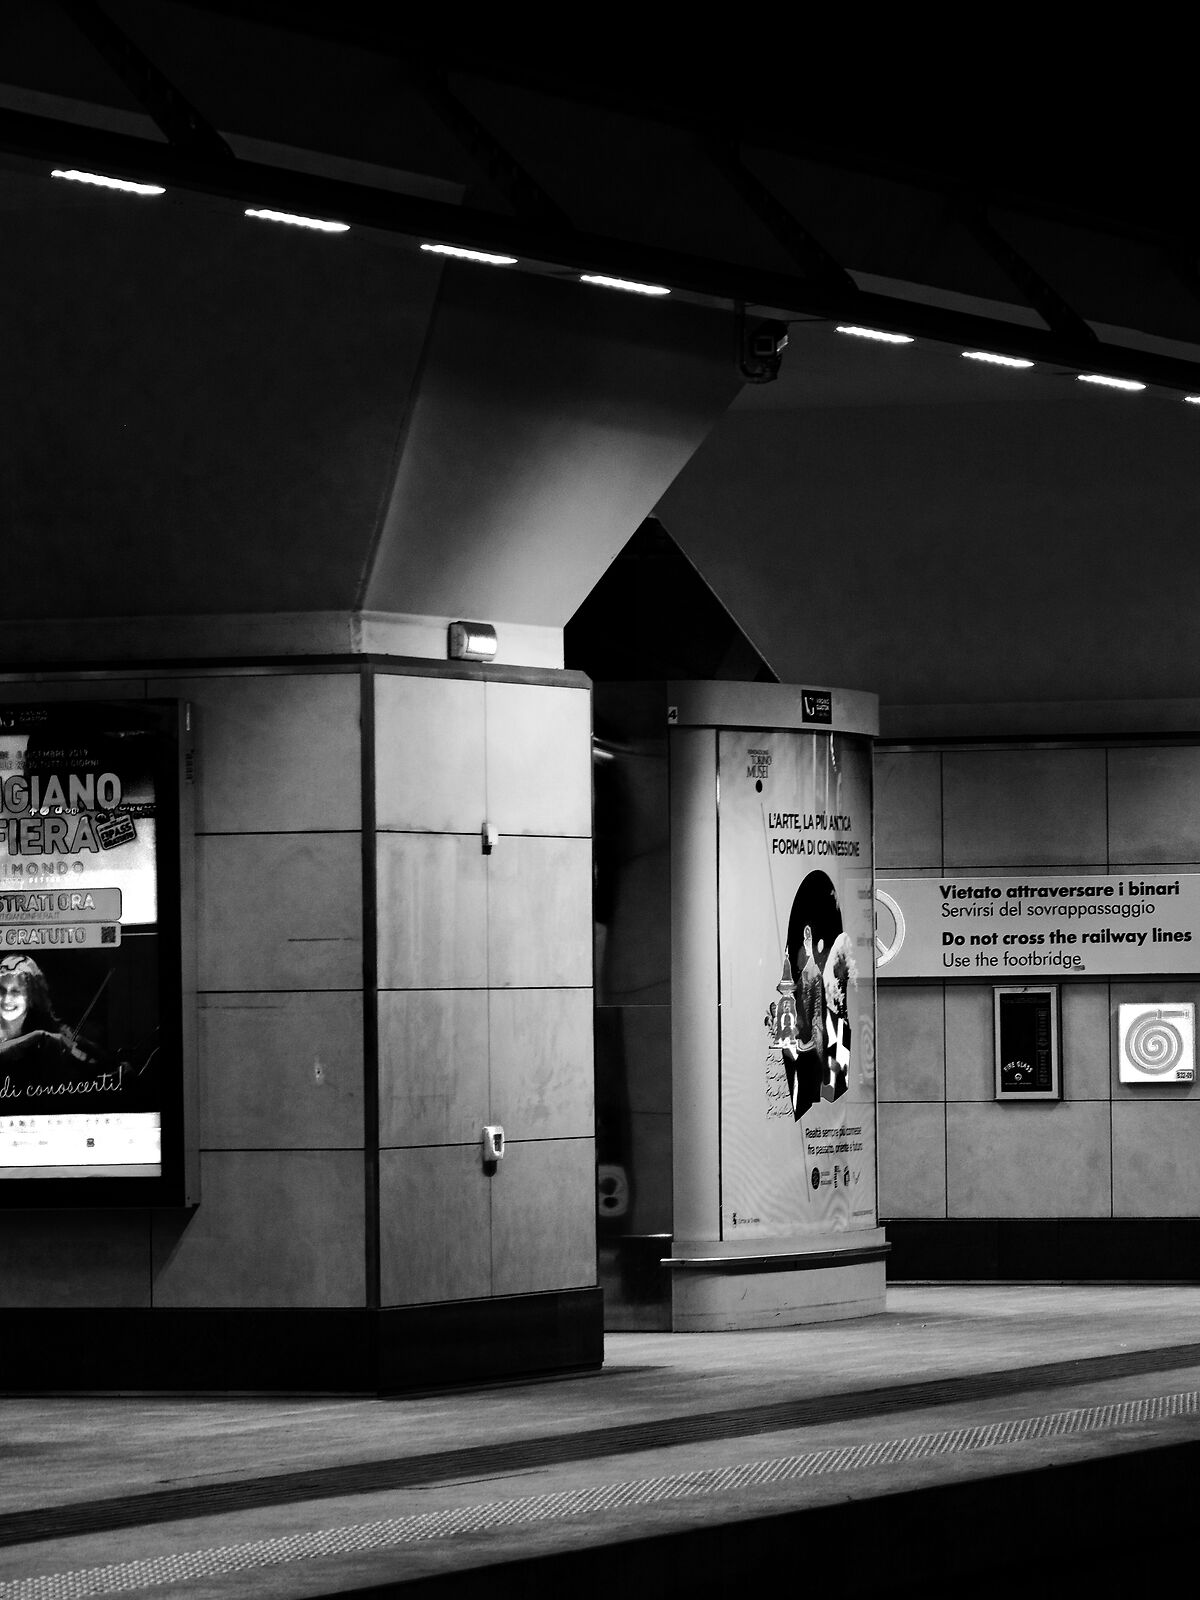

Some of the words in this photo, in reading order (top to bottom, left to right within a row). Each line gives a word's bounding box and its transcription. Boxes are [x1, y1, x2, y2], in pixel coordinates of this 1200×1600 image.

[669, 709, 677, 720] 4
[0, 772, 122, 813] GIANO
[768, 812, 801, 832] L'ARTE,
[803, 814, 815, 829] LA
[829, 815, 852, 832] ANTICA
[772, 839, 806, 855] FORMA
[807, 839, 816, 856] DI
[817, 839, 860, 857] CONNESSIONE
[939, 884, 1002, 900] Vietato
[1006, 884, 1115, 899] attraversare
[1118, 882, 1124, 897] i
[1128, 881, 1180, 897] binari
[941, 901, 994, 918] Servirsi
[999, 901, 1022, 917] del
[1027, 900, 1156, 918] sovrappassaggio
[6, 926, 86, 945] GRATUITO
[942, 931, 966, 946] Do
[970, 931, 998, 946] not
[1002, 933, 1046, 946] cross
[1049, 929, 1078, 945] the
[1081, 928, 1148, 947] railway
[1152, 927, 1193, 943] lines
[943, 952, 971, 968] Use
[975, 951, 999, 967] the
[1003, 950, 1083, 971] footbridge
[0, 1076, 22, 1098] di
[26, 1065, 124, 1097] conoscerti!
